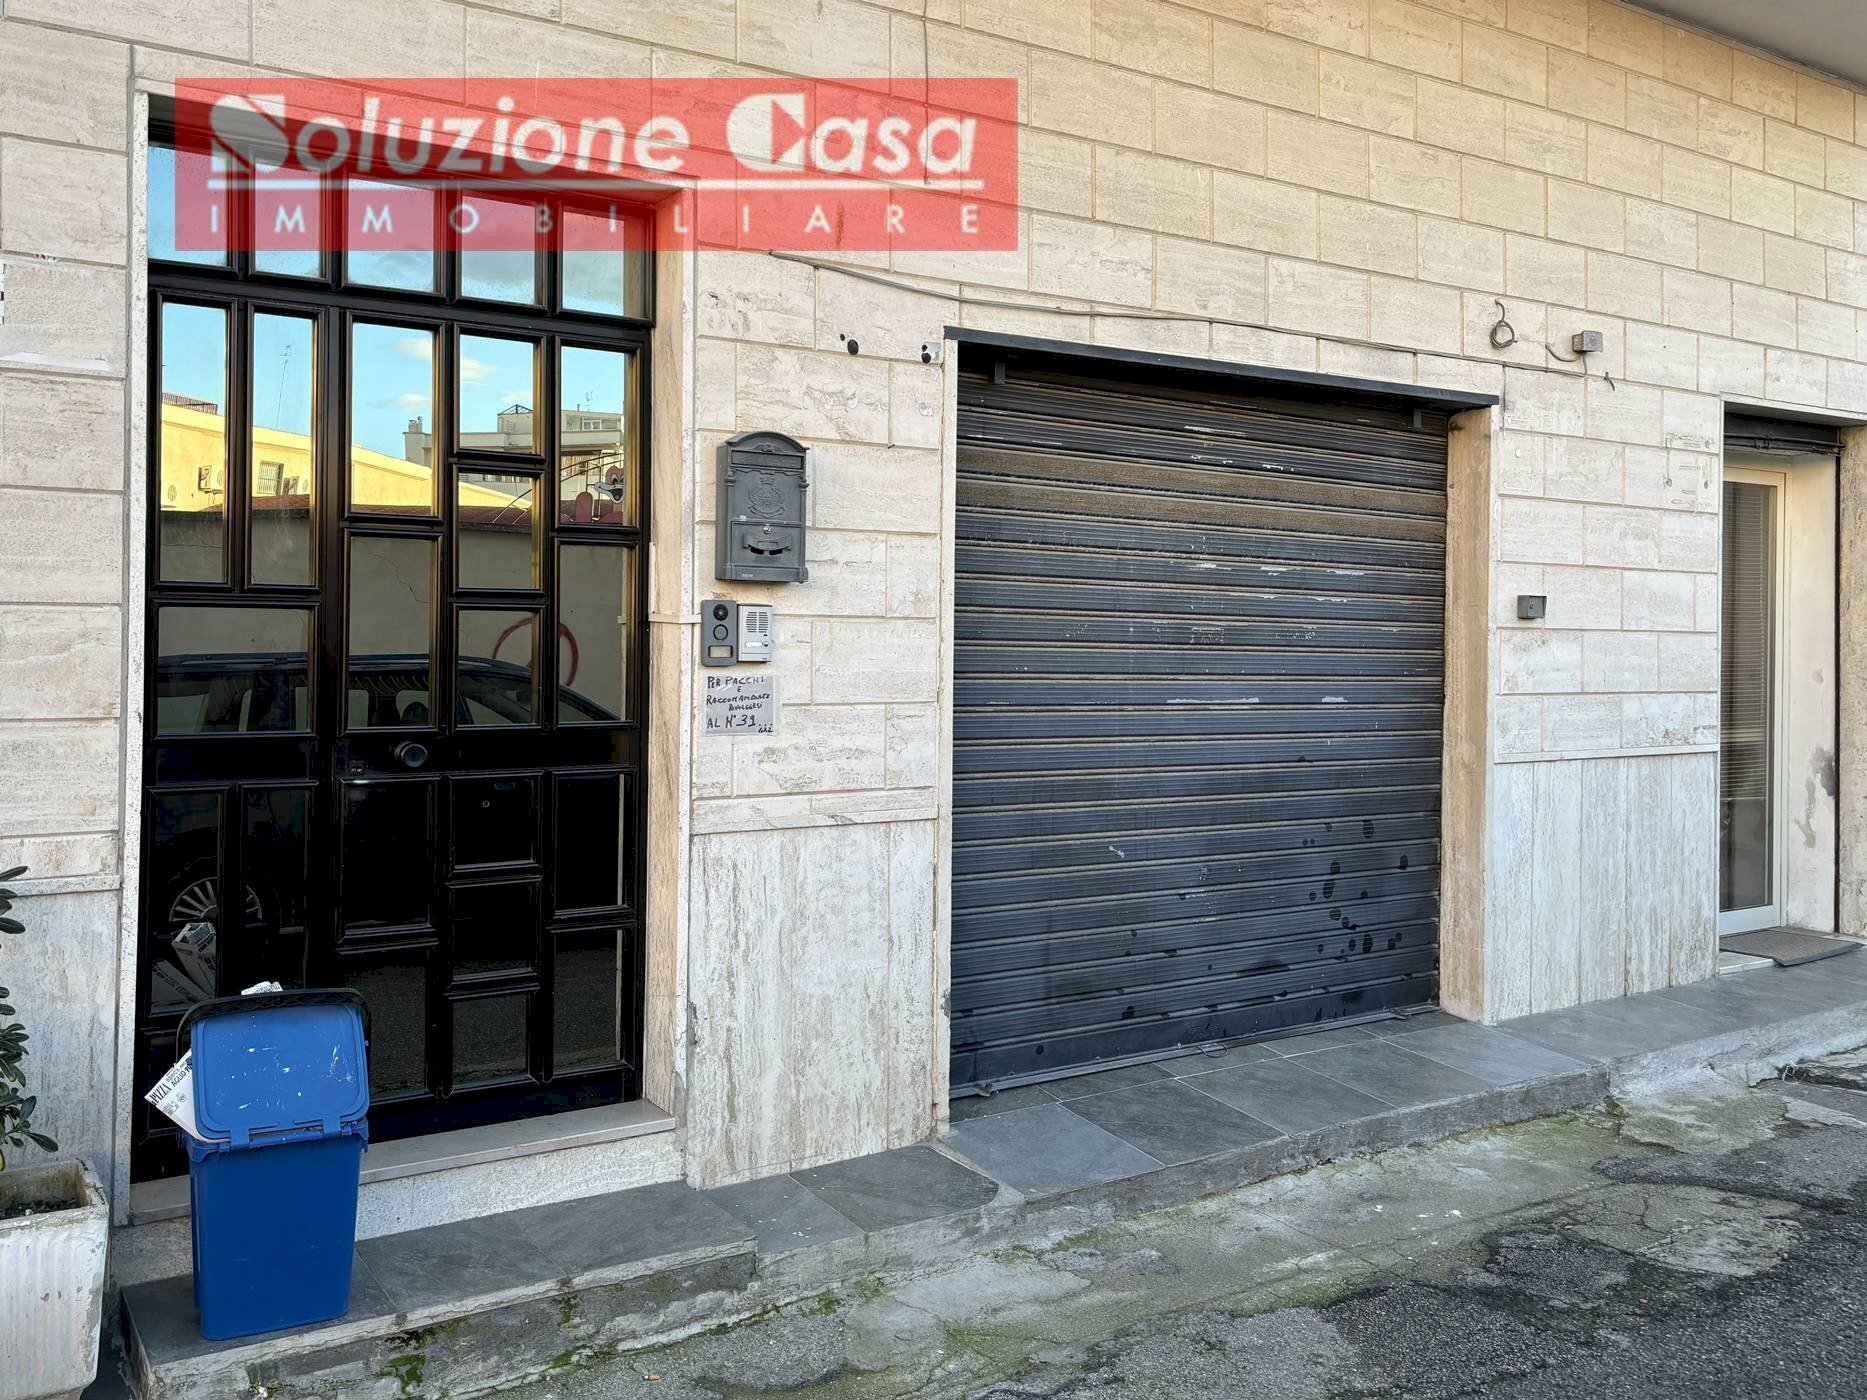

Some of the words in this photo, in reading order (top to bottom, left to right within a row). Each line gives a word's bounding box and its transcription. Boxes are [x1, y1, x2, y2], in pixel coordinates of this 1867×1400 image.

[707, 675, 722, 689] PER
[725, 675, 764, 686] PACCHI
[707, 717, 721, 729] AL
